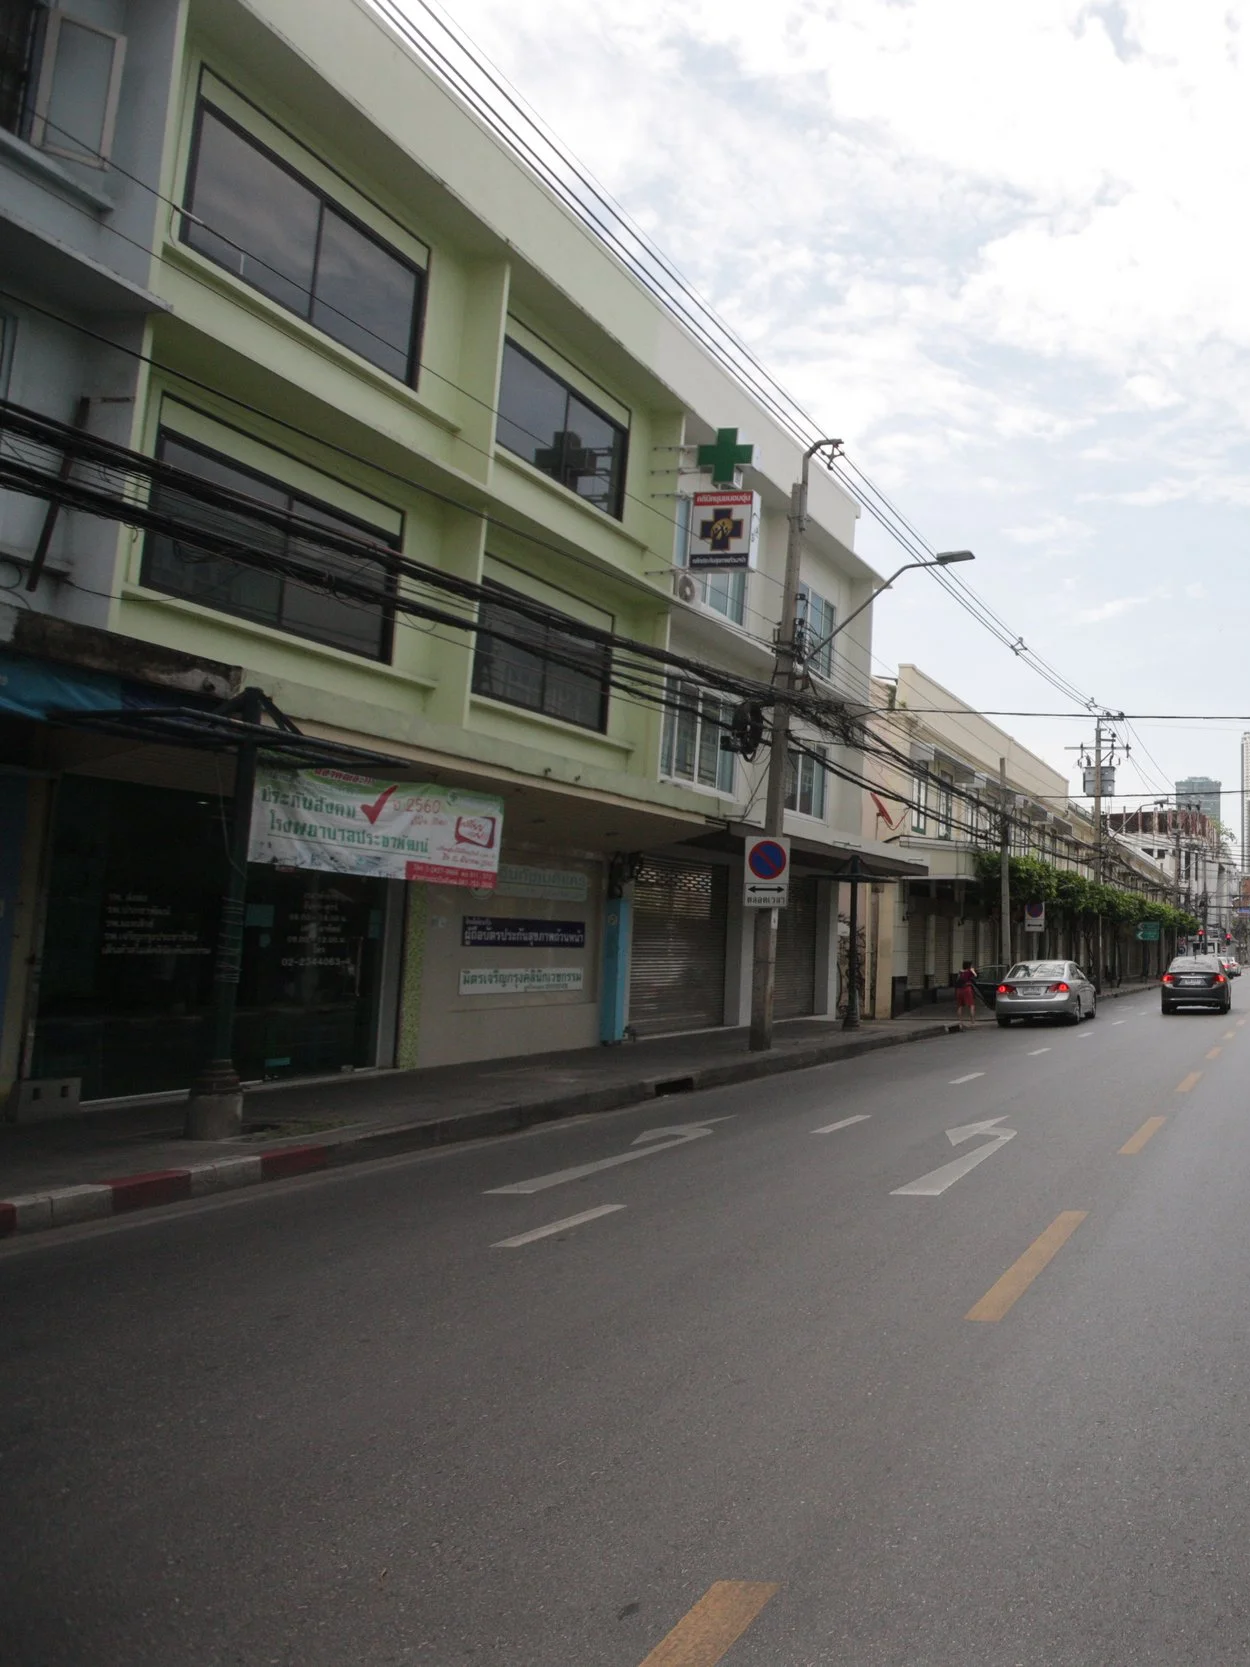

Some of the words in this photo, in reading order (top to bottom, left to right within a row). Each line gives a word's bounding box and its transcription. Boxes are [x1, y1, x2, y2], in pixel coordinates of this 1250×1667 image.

[260, 785, 356, 818] ประกันสังคม
[406, 798, 441, 814] 2560
[269, 809, 429, 853] โรงพยาบาลประชาพัฒน์
